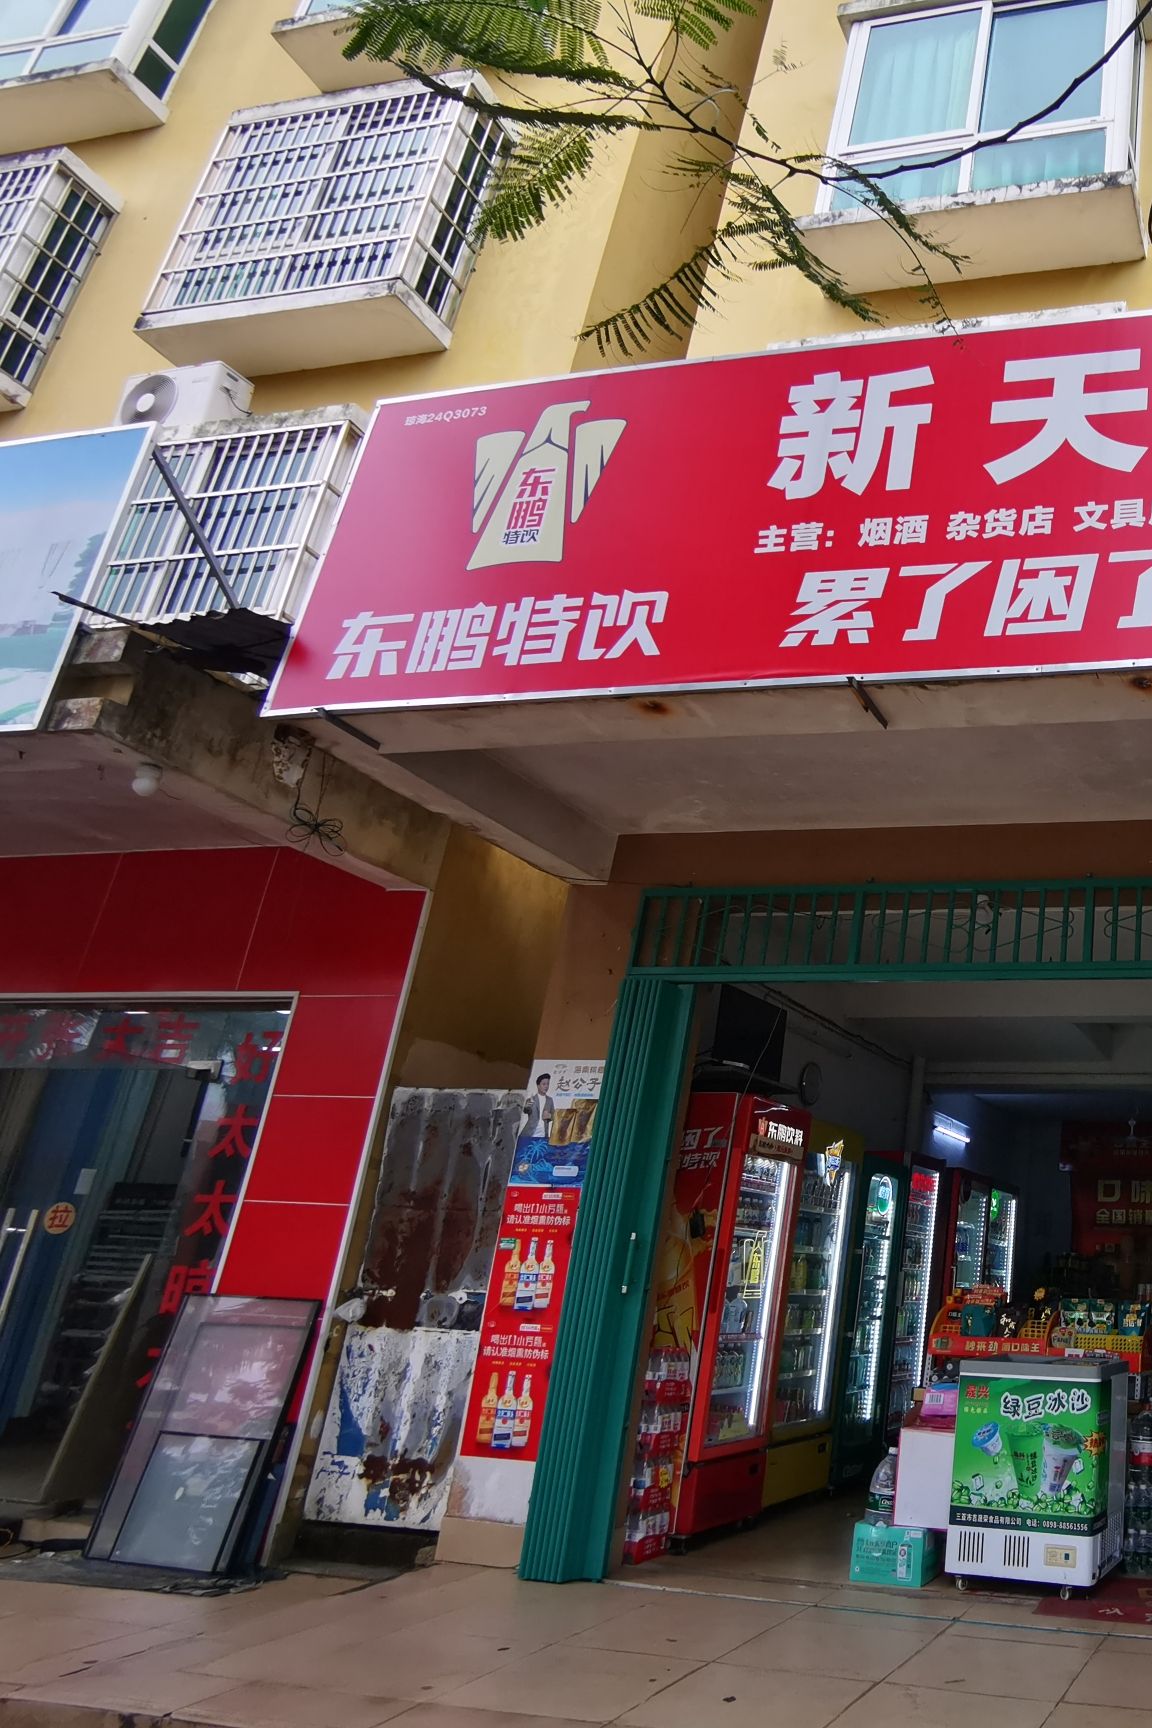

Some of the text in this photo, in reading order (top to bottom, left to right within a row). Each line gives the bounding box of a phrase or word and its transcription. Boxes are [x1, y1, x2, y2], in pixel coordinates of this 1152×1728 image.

[858, 516, 928, 549] 烟酒
[945, 505, 1054, 541] 杂货店
[325, 590, 669, 681] 东鹏特饮
[556, 1075, 601, 1092] 赵公子
[768, 1121, 803, 1147] 东鹏饮料
[48, 1205, 73, 1229] 拉
[1001, 1389, 1090, 1420] 绿豆冰沙
